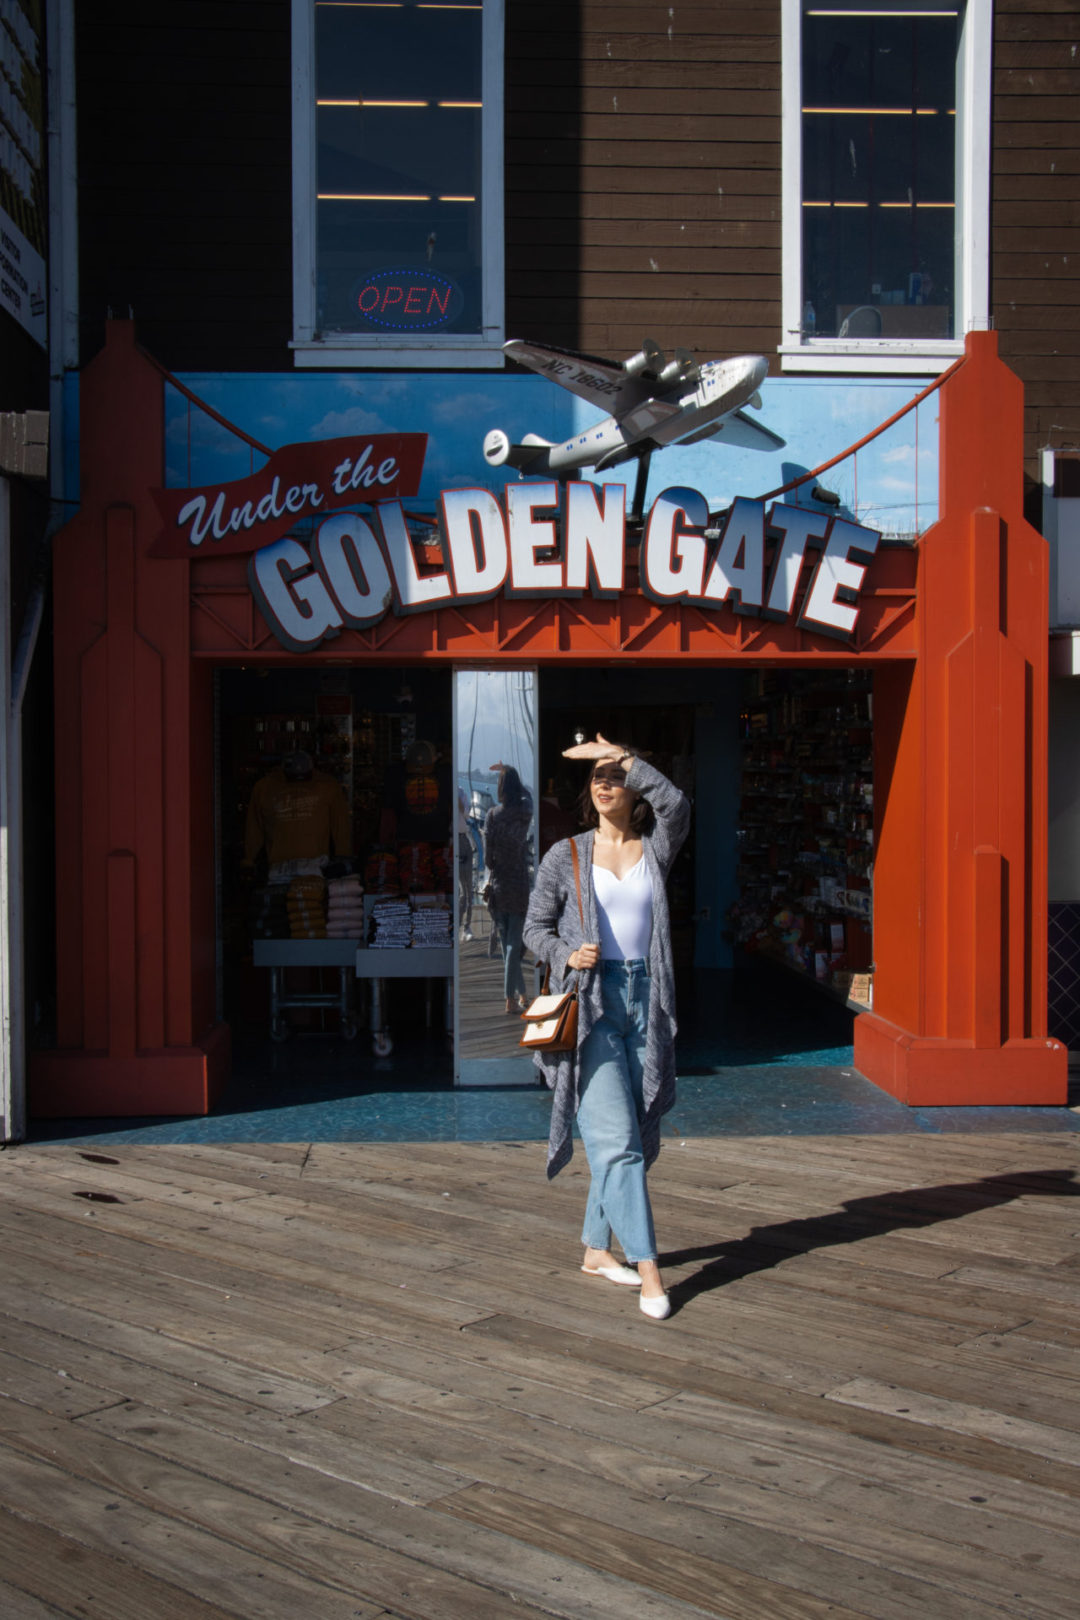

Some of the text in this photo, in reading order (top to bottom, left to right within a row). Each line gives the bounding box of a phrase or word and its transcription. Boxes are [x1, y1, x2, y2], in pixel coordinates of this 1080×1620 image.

[358, 286, 451, 314] OPEN
[541, 359, 573, 375] NC
[178, 443, 400, 546] Under the
[250, 480, 883, 648] GOLDEN GATE
